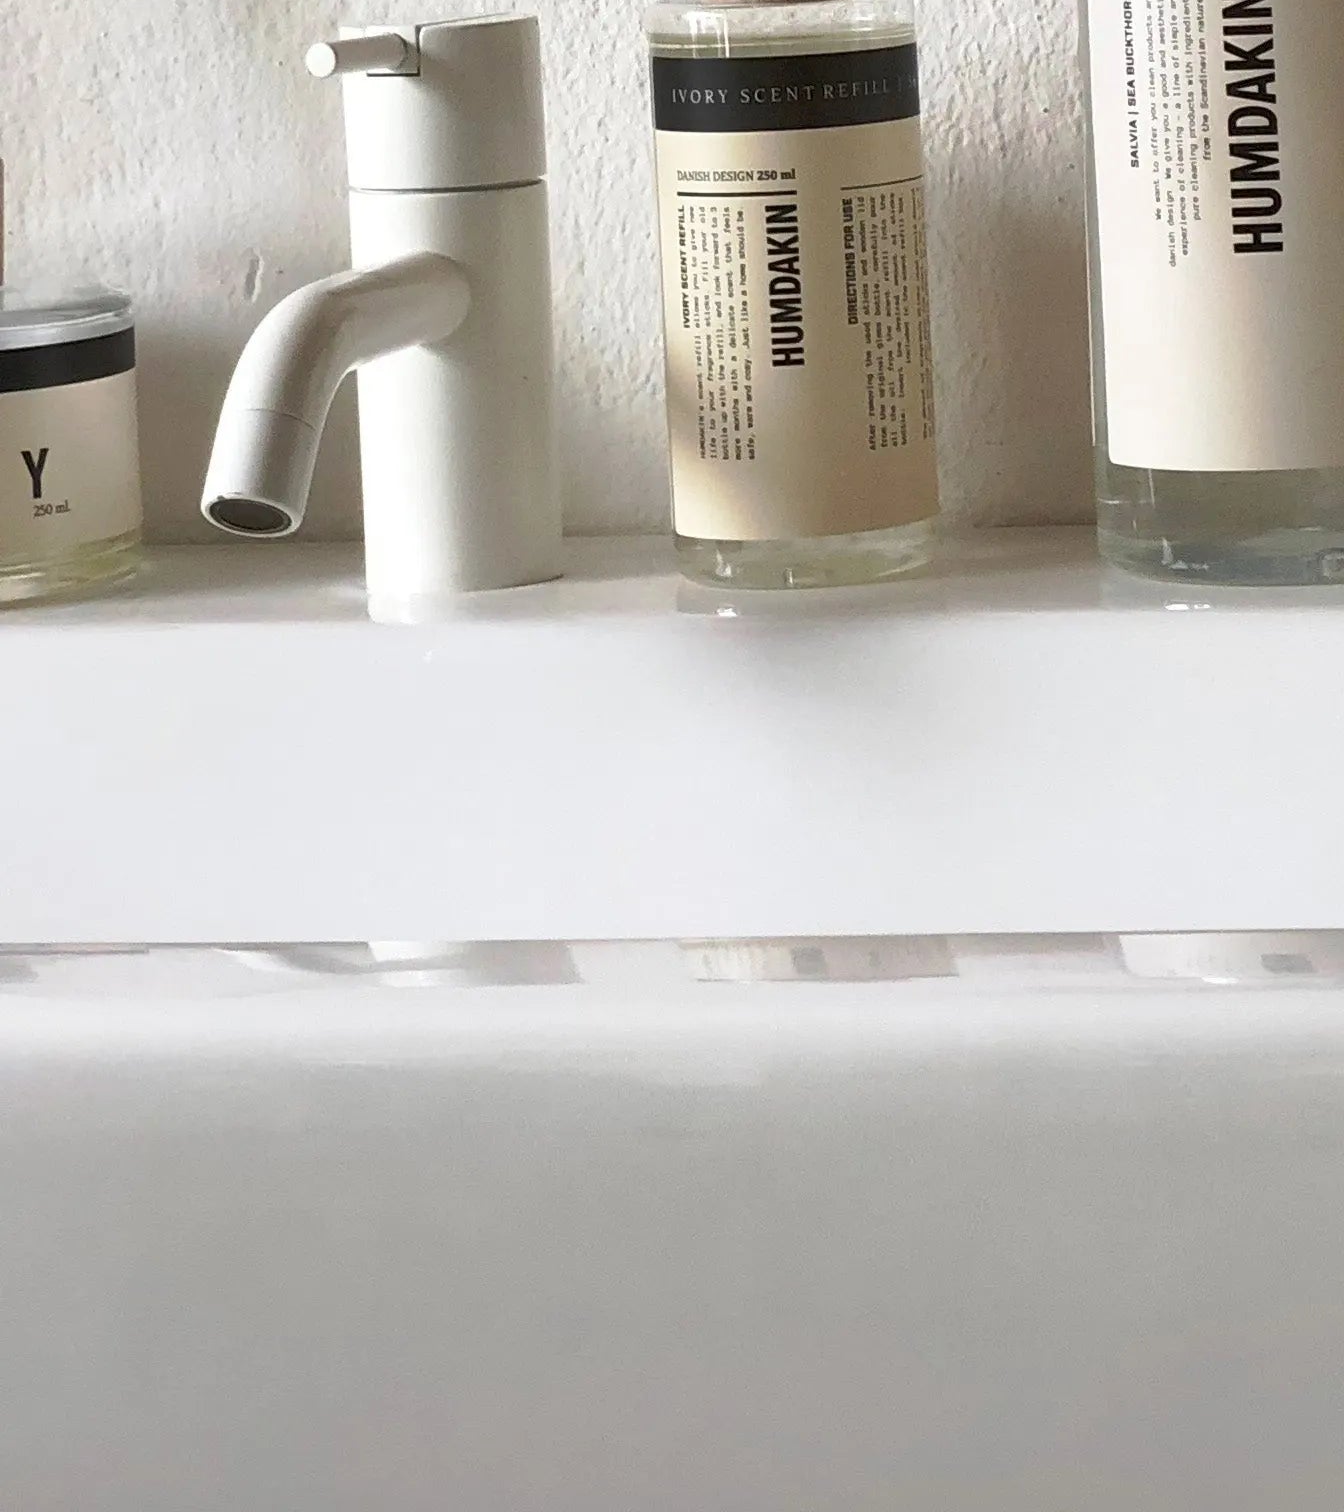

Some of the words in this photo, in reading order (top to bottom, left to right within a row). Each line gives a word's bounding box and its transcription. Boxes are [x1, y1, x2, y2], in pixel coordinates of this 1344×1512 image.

[1196, 37, 1208, 108] Scandinavian
[672, 89, 728, 104] IVORY
[740, 86, 815, 103] SCENT
[823, 79, 891, 100] REFILL
[1126, 79, 1136, 106] SEA
[1200, 113, 1209, 132] the
[1128, 119, 1139, 167] SALVIA
[1201, 136, 1211, 160] from
[677, 170, 711, 181] DANISH
[713, 170, 753, 182] DESIGN
[757, 170, 777, 180] 250
[781, 168, 796, 179] ml
[841, 197, 853, 222] USE
[677, 205, 686, 246] REFILL
[842, 224, 855, 249] FOR
[679, 250, 688, 289] SCENT
[765, 204, 804, 367] HUMDAKIN
[844, 251, 858, 324] DIRECTIONS
[681, 292, 690, 328] IVORY
[33, 504, 53, 517] 250
[55, 499, 71, 513] ml
